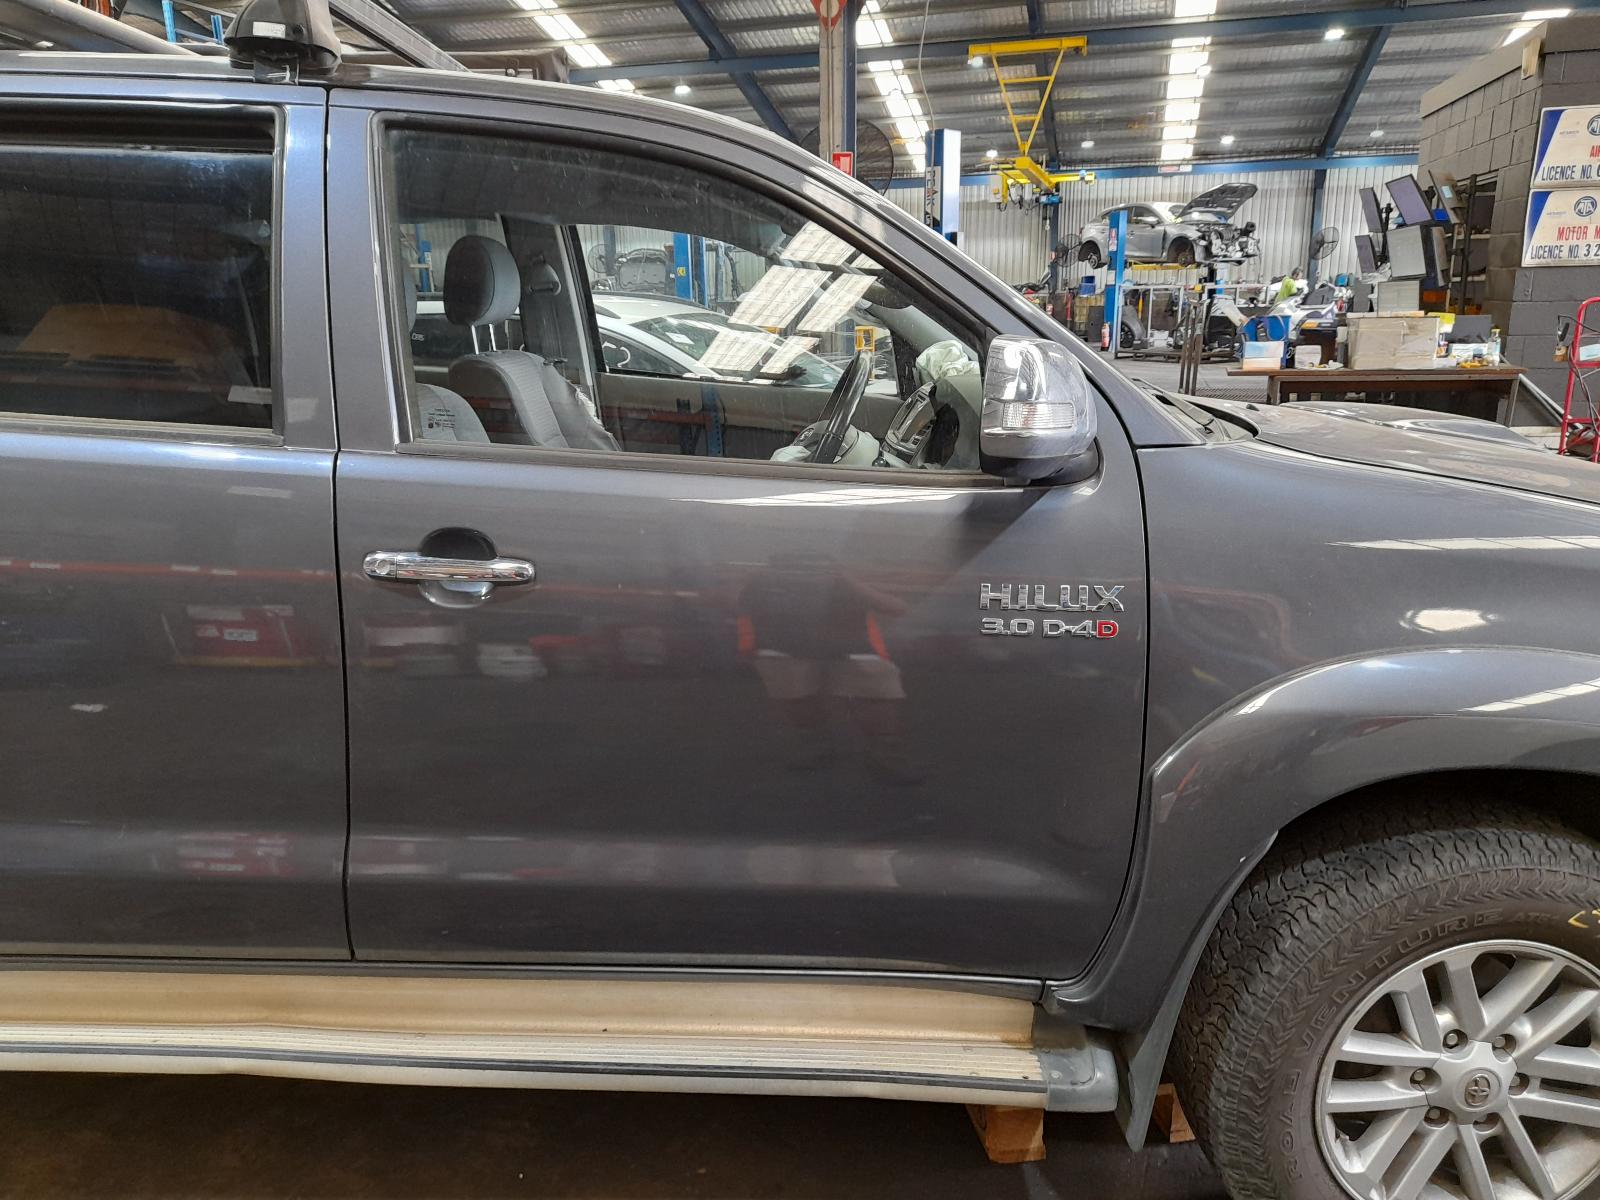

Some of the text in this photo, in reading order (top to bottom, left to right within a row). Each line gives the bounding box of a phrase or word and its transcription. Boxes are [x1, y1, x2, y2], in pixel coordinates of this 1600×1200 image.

[1541, 165, 1576, 181] LICENCE
[1580, 164, 1593, 179] NO.
[1557, 226, 1588, 241] MOTOR
[1530, 244, 1564, 260] LICENCE
[1568, 244, 1580, 259] NO.
[979, 583, 1125, 612] HILUX
[980, 617, 1119, 638] 3.0 D-4D
